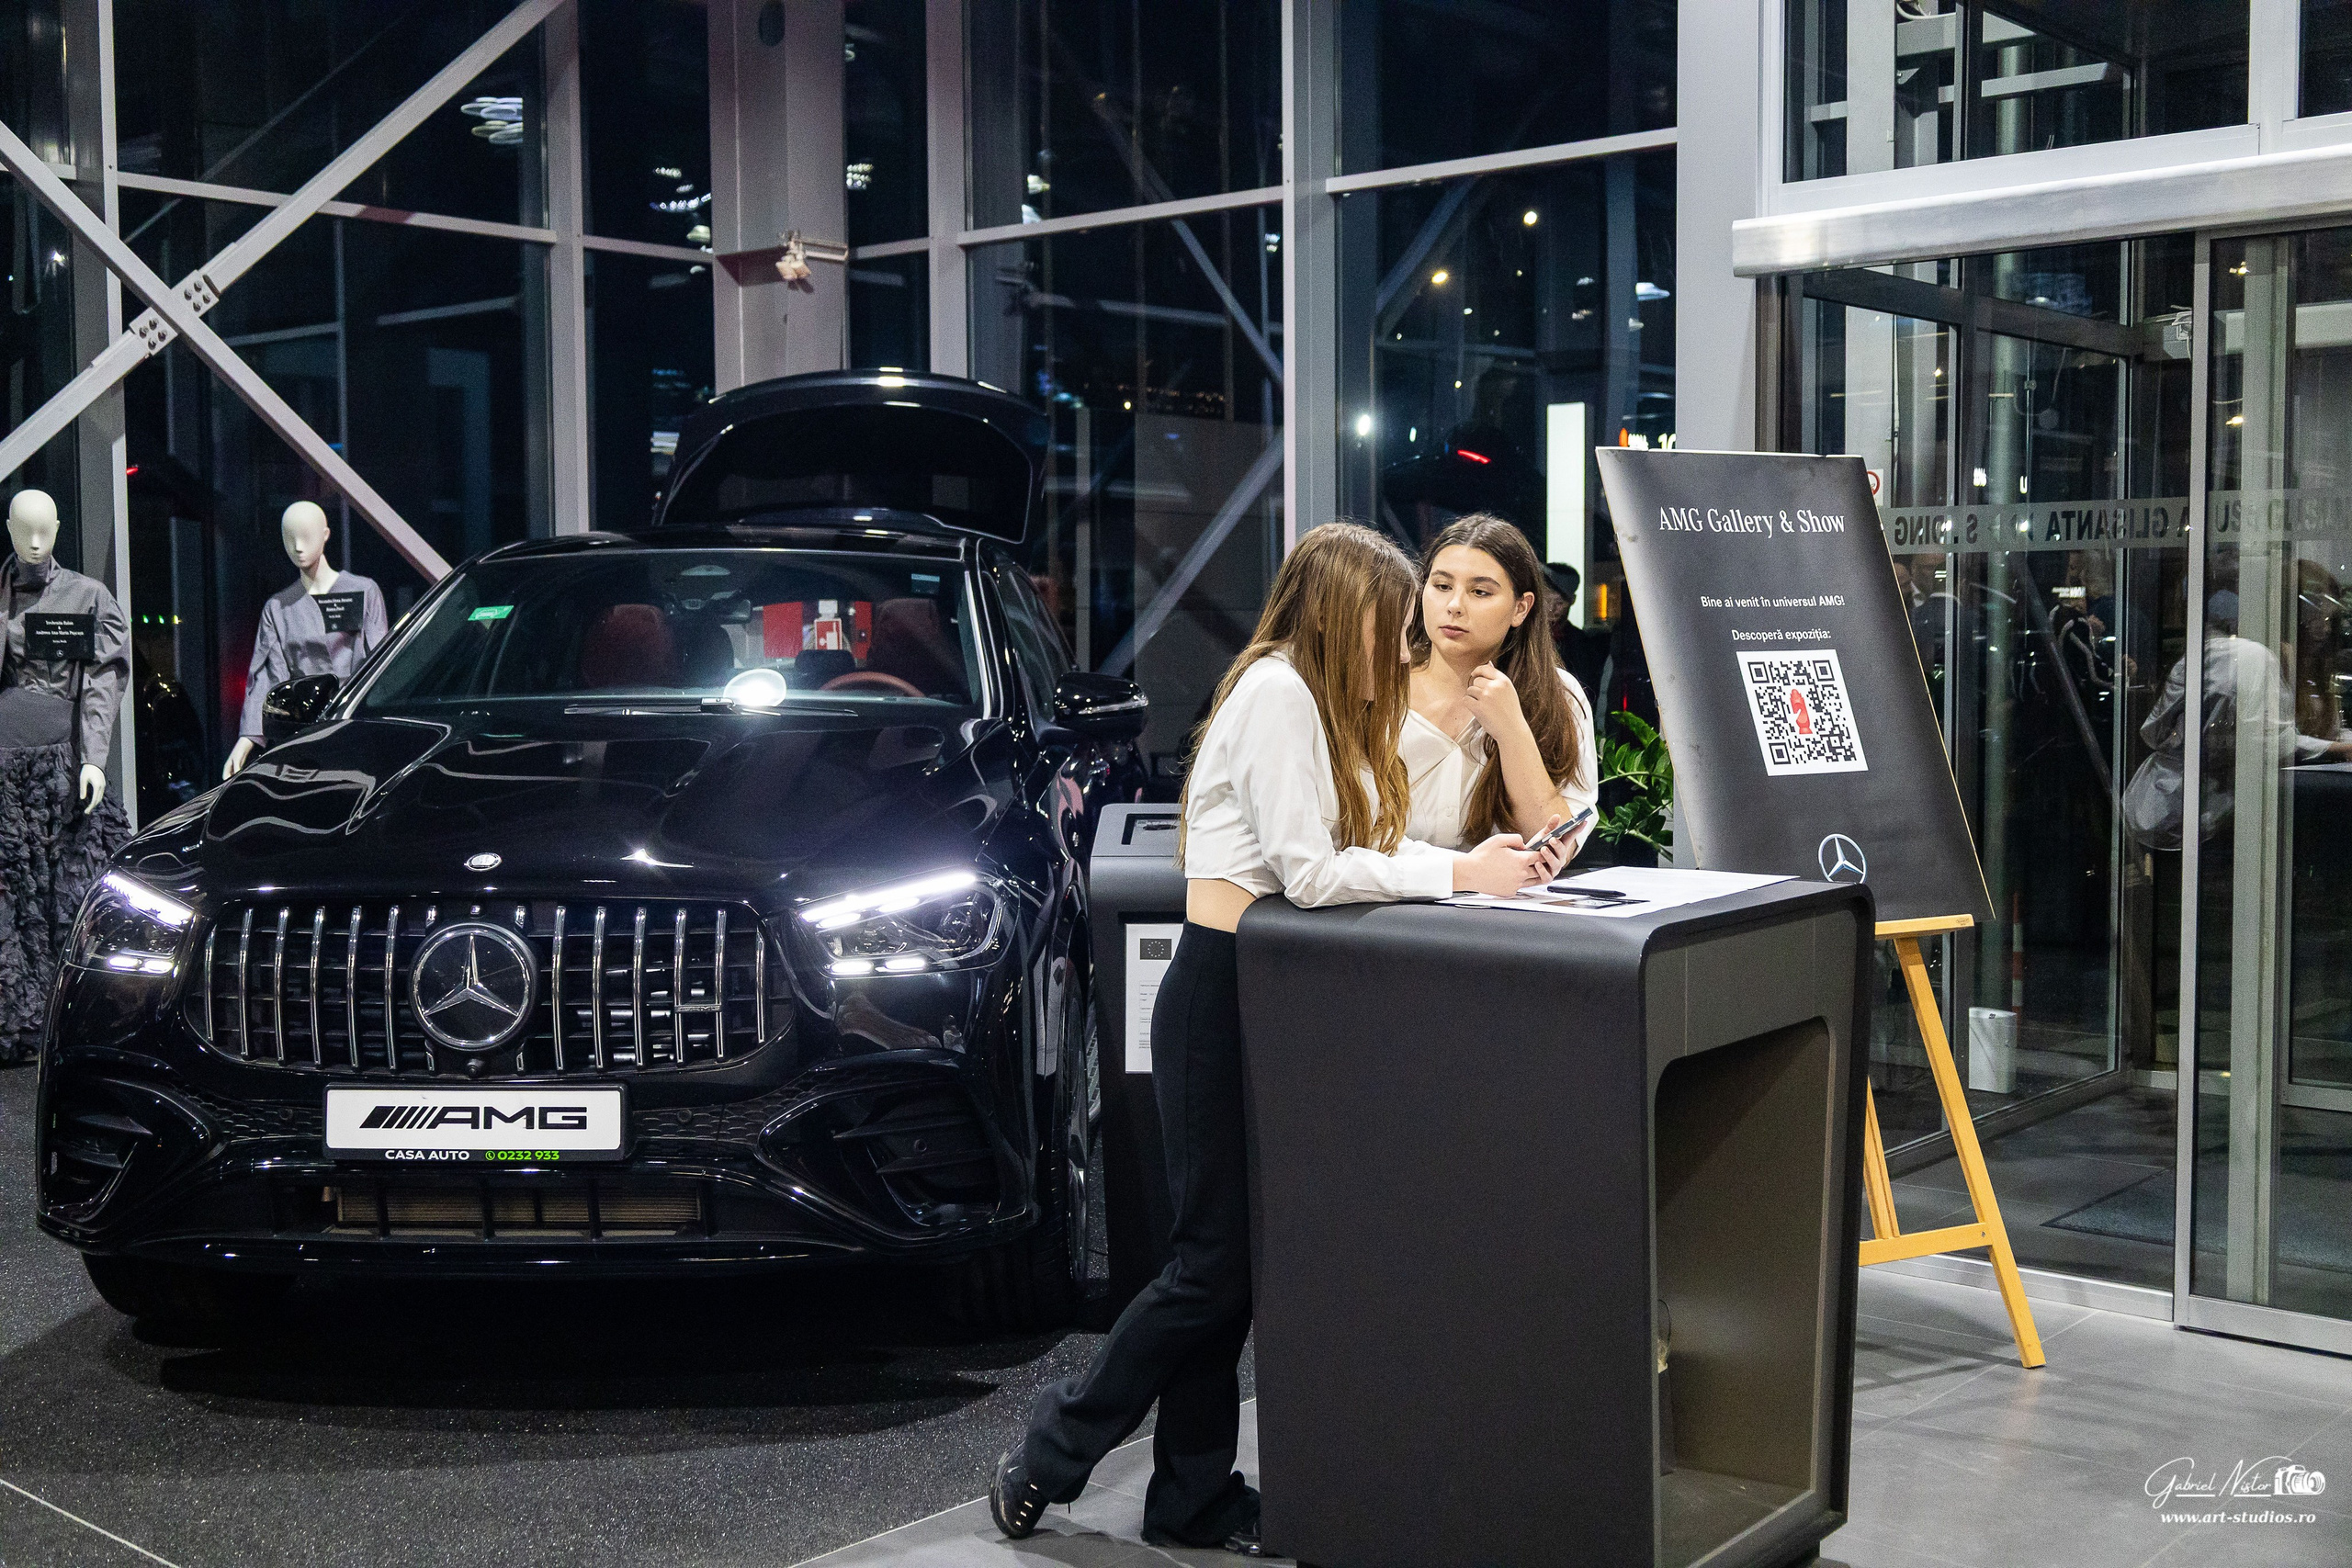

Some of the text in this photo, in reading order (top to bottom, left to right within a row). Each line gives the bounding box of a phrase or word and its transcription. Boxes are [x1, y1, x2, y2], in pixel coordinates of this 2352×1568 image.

[1659, 506, 1845, 538] AMG Gallery & Show
[1701, 595, 1845, 607] Bine ai venit în universul AMG!
[1731, 628, 1831, 642] Descoperă expoziția:
[426, 1106, 587, 1129] AMG
[385, 1150, 560, 1160] CASA AUTO 0232 933
